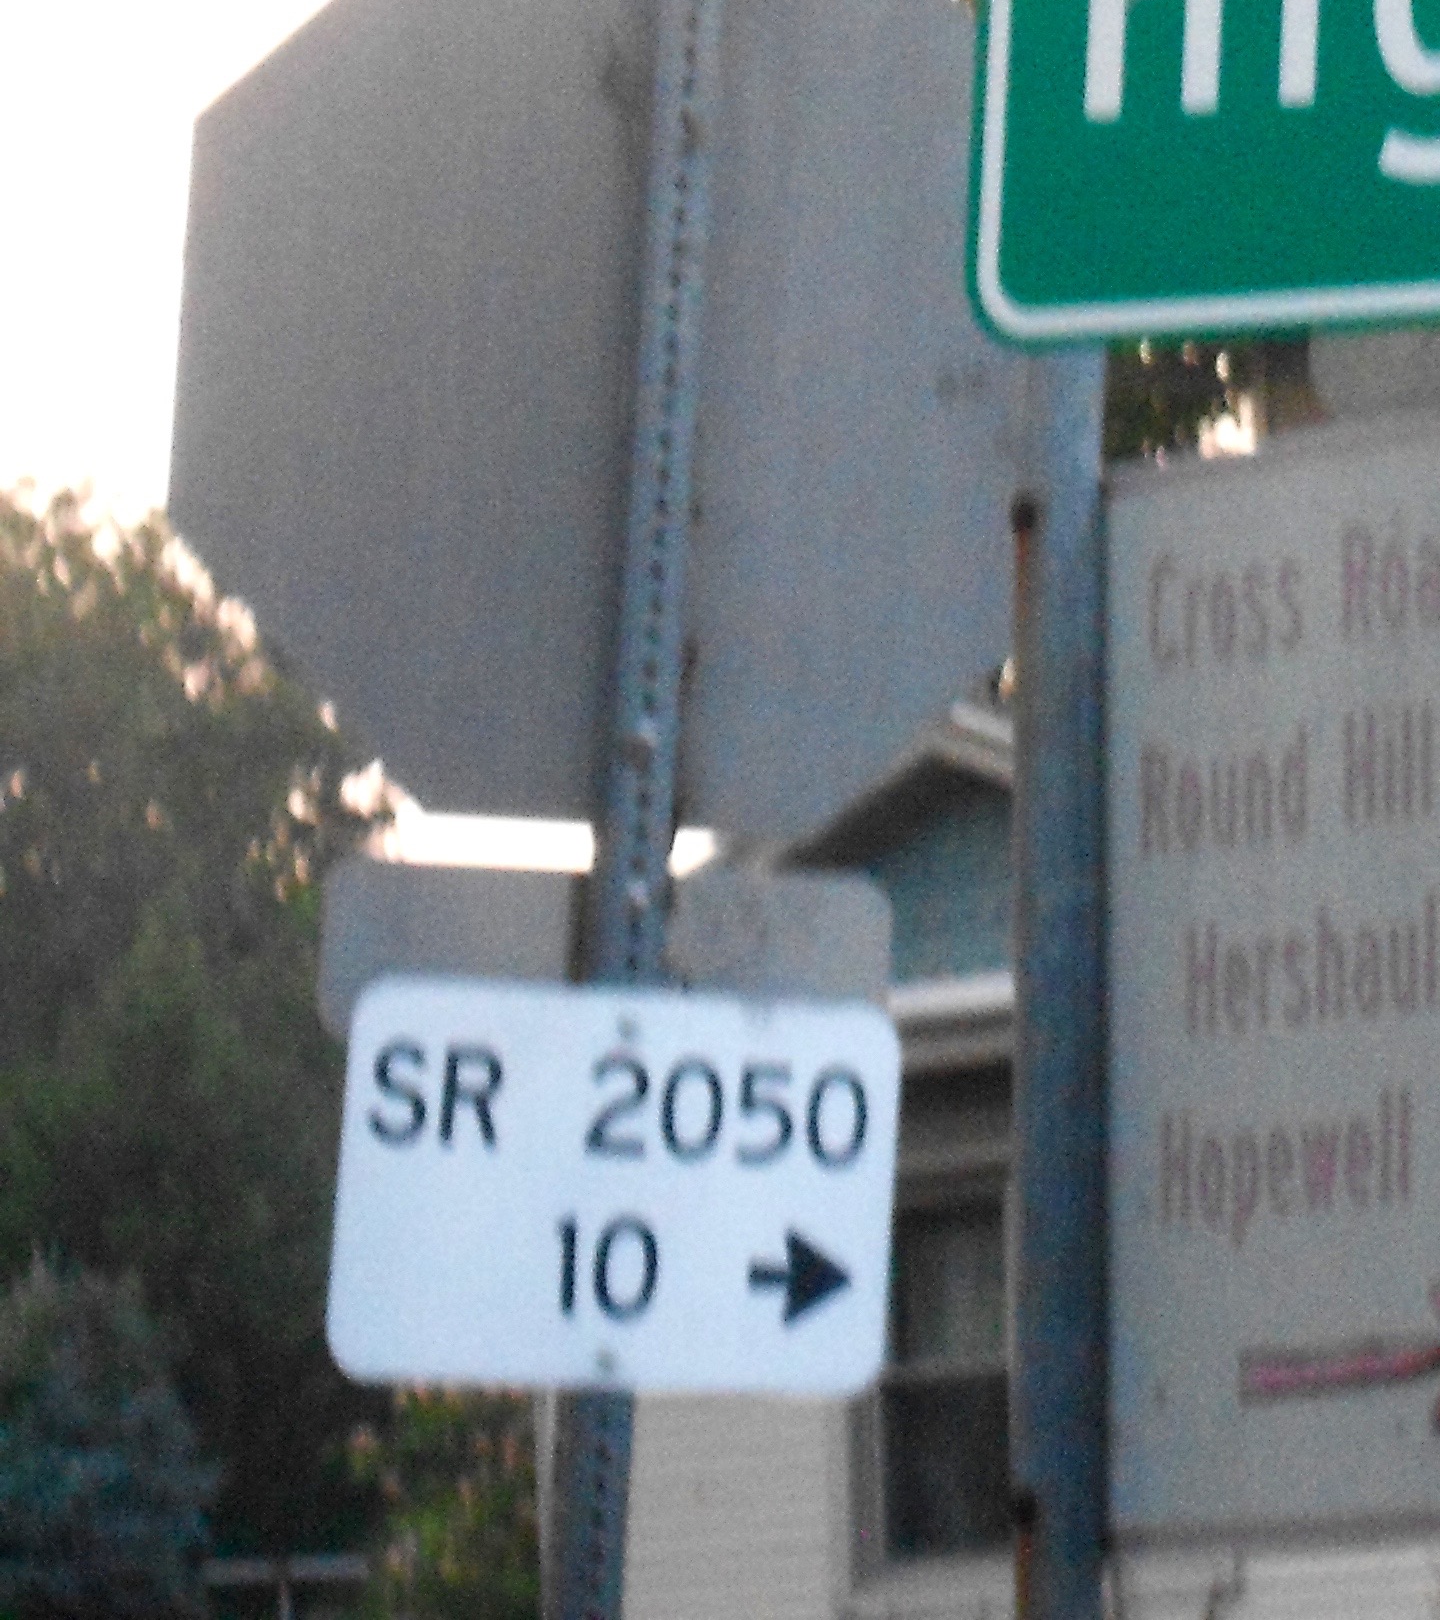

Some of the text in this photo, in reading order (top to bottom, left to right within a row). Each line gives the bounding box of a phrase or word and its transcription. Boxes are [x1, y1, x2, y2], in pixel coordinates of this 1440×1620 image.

[1149, 552, 1304, 672] Cross
[1139, 721, 1309, 860] Round
[1342, 696, 1434, 830] Hill
[367, 1035, 869, 1171] SR 2050
[1159, 1082, 1413, 1248] Hopewell
[559, 1211, 659, 1322] 10
